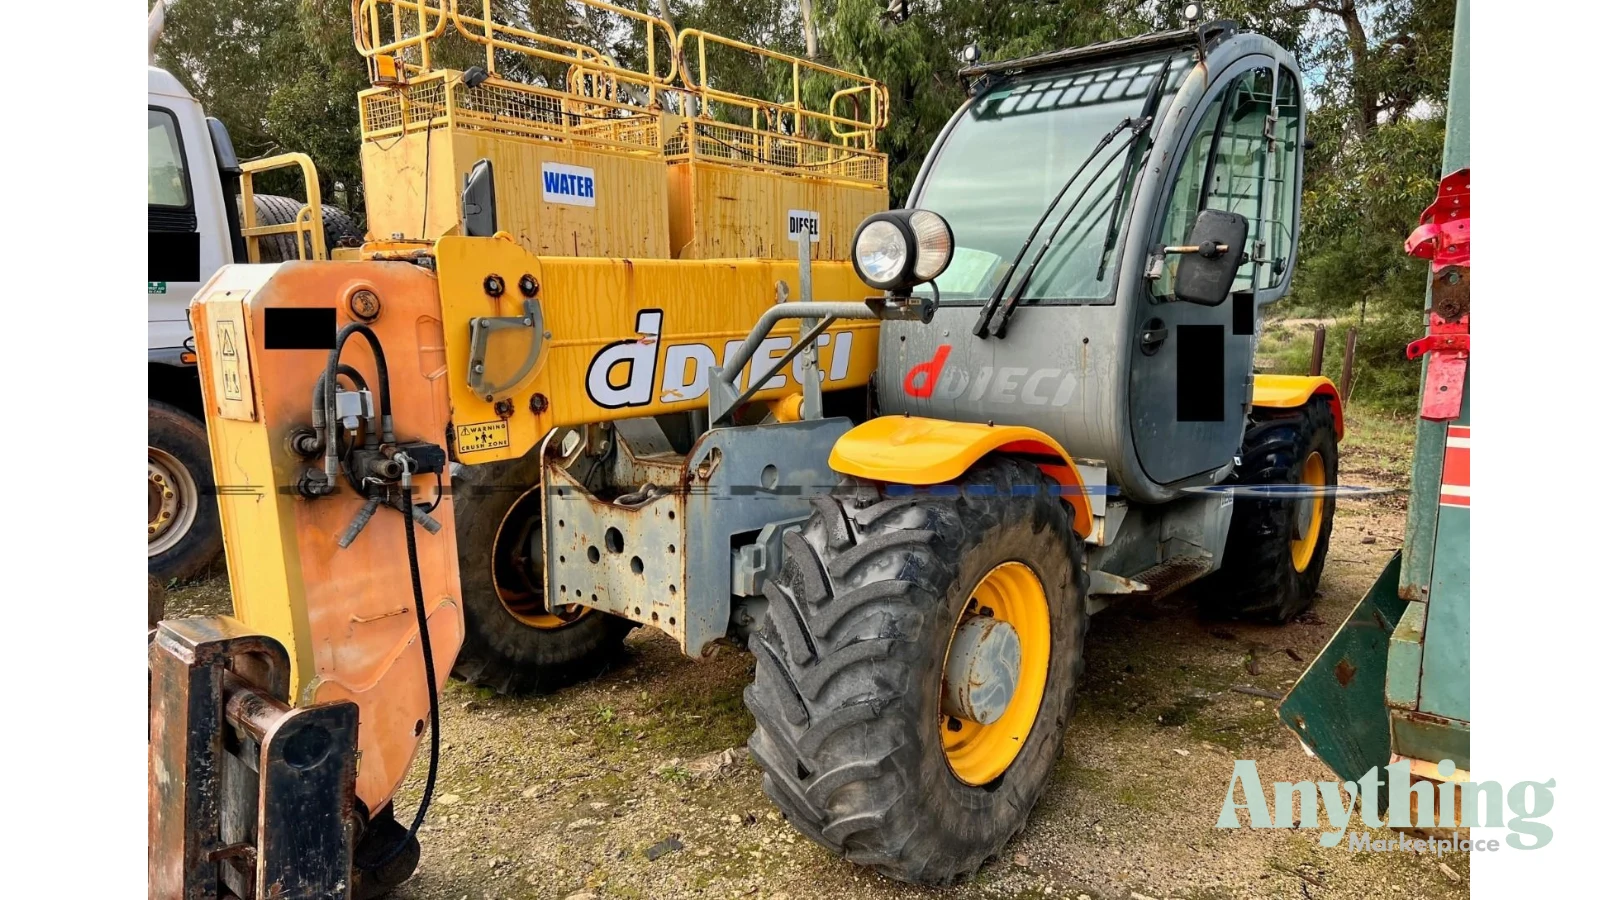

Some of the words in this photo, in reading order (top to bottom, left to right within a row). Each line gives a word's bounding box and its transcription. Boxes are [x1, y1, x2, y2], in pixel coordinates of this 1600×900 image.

[543, 171, 594, 198] WATER
[789, 216, 819, 235] DIESEL
[471, 424, 505, 432] WARNING
